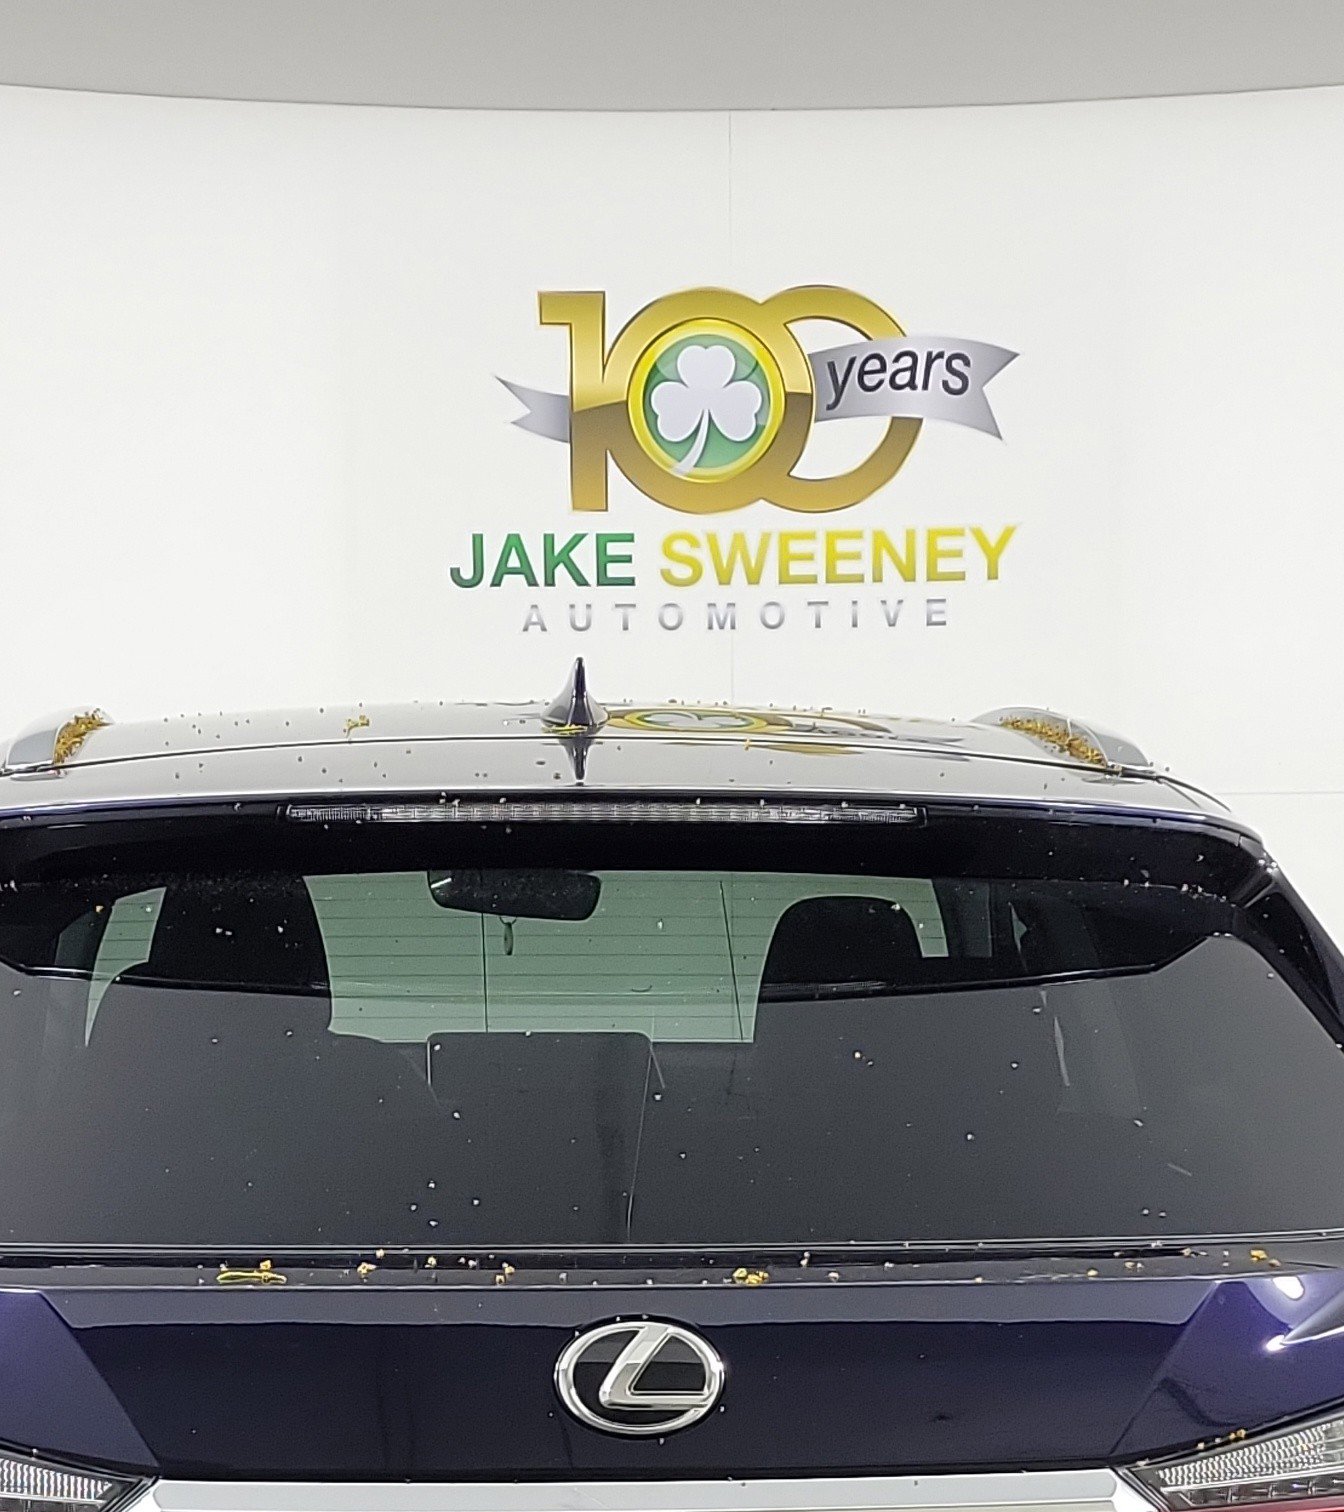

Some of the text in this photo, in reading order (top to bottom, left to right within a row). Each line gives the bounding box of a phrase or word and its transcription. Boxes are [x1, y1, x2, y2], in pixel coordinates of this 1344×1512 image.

[538, 284, 923, 514] 100
[826, 346, 971, 410] years
[449, 525, 1017, 588] JAKE SWEENEY
[522, 599, 949, 632] AUTOMOTIVE
